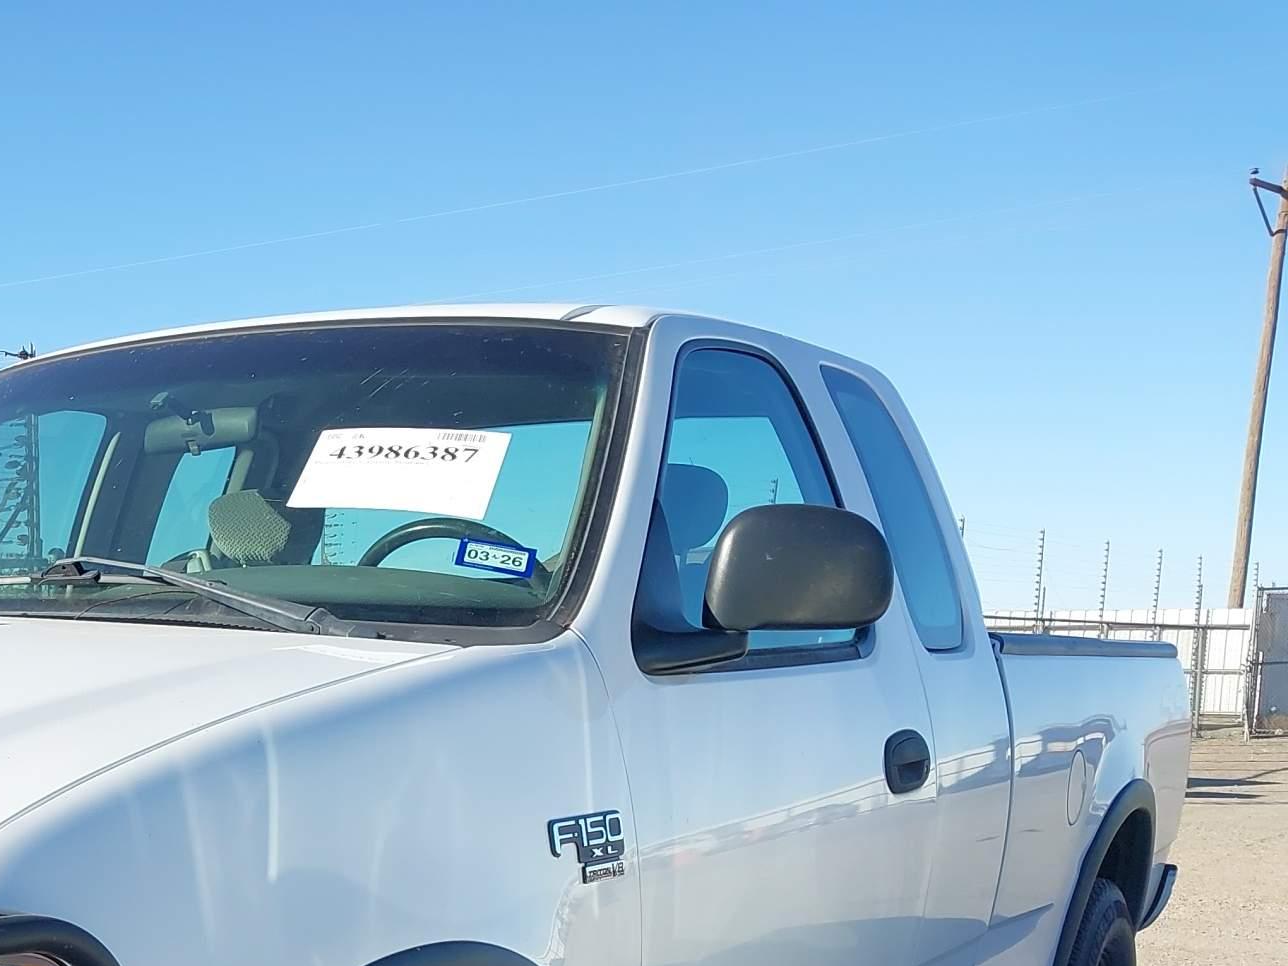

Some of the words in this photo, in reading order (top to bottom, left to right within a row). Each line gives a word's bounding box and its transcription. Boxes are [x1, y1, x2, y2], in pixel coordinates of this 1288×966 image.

[329, 445, 479, 463] 43986387
[467, 548, 490, 561] 03
[499, 554, 523, 567] 26
[591, 845, 619, 858] XL
